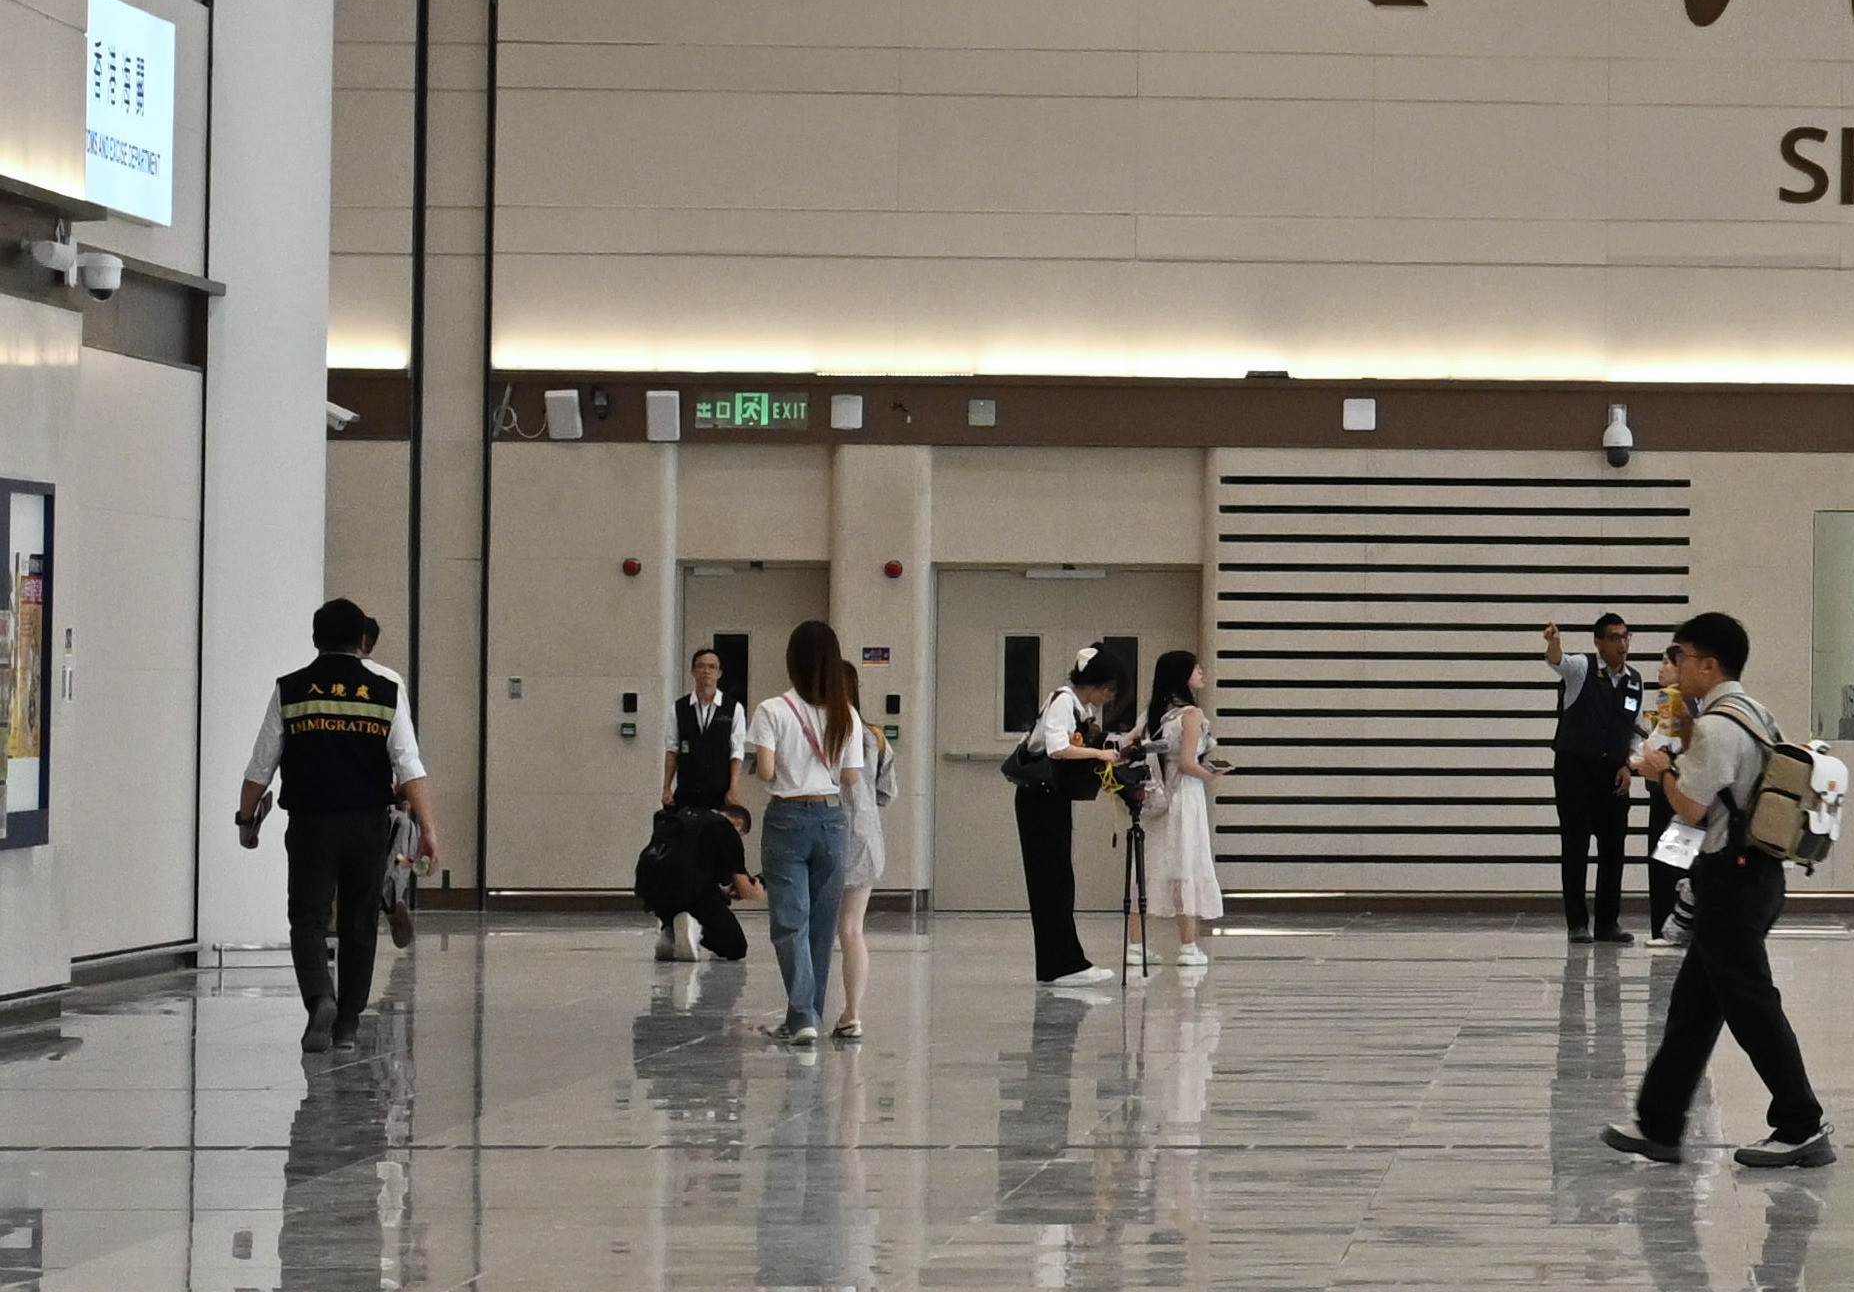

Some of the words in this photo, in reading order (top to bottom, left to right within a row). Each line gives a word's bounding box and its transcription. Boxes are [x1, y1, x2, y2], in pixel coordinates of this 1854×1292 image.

[696, 401, 731, 419] 出口
[772, 402, 807, 419] EXIT
[290, 717, 390, 738] IMMIGRATION
